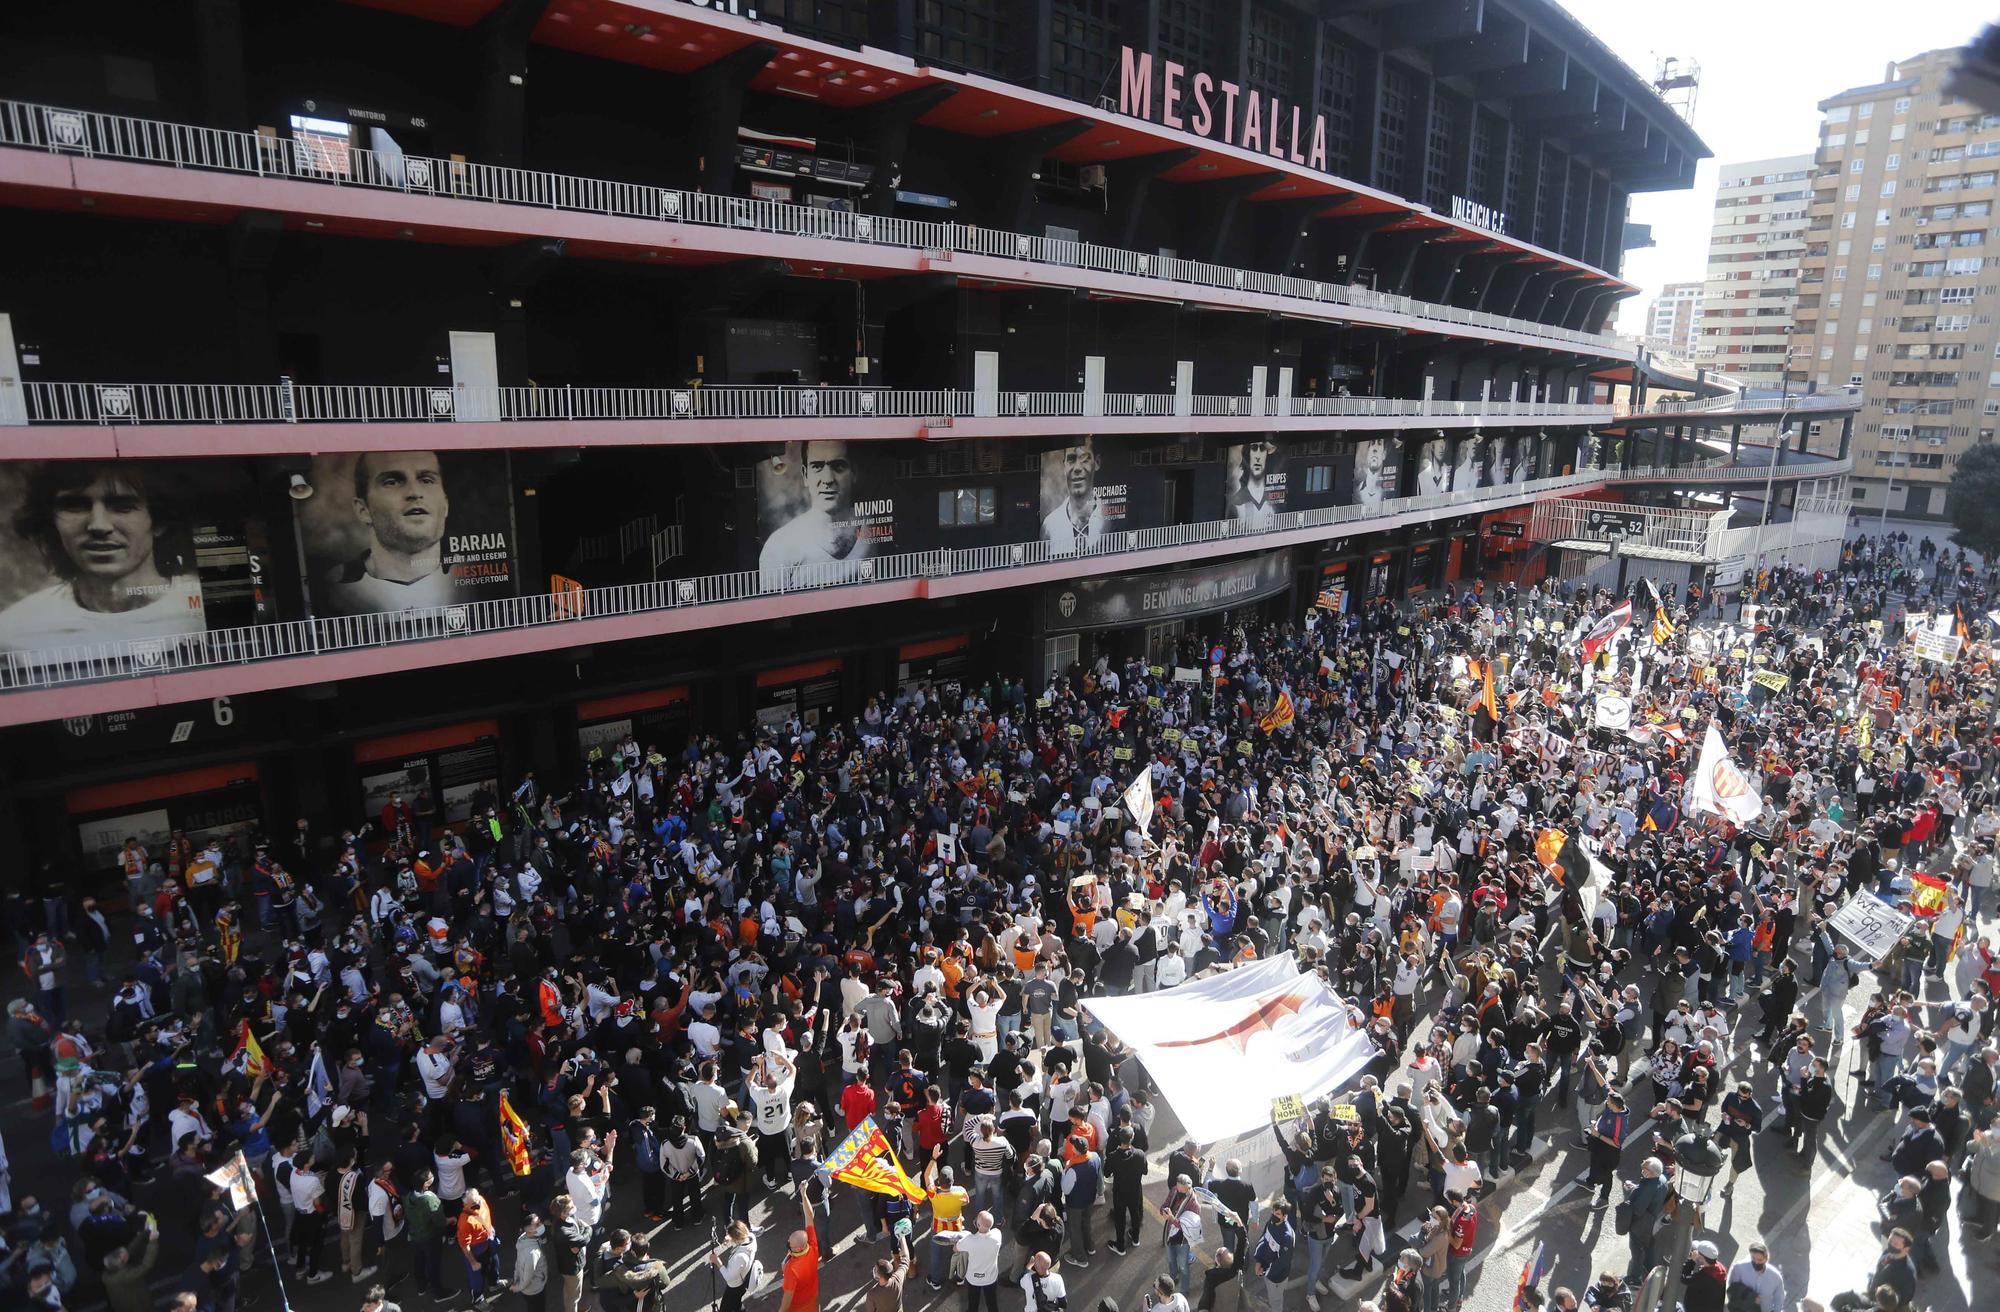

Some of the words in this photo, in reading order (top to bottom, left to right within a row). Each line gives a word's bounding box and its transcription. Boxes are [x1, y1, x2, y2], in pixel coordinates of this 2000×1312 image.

[1120, 45, 1327, 171] MESTALLA
[347, 108, 386, 121] VOMITORIO
[410, 117, 426, 128] 405
[1452, 195, 1490, 230] VALENCIA
[1491, 210, 1505, 235] C.F.
[854, 499, 893, 517] MUNDO
[876, 515, 893, 524] LEGEND
[1629, 521, 1643, 533] 52
[449, 532, 506, 553] BARAJA
[443, 554, 465, 565] HEART
[467, 553, 481, 562] AND
[482, 551, 507, 561] LEGEND
[451, 562, 509, 577] MESTALLA
[455, 574, 509, 587] FOREVERTOUR
[1143, 585, 1210, 611] BENVINGUTS
[1212, 586, 1218, 599] A
[1221, 573, 1257, 598] MESTALLA
[1755, 674, 1782, 690] HOME
[107, 711, 136, 724] PORTA
[212, 696, 234, 727] 6
[109, 723, 128, 733] GATE
[1856, 894, 1880, 916] WE
[1886, 917, 1908, 936] ARE
[1854, 916, 1886, 948] 99%
[1278, 1095, 1293, 1105] LIM
[1281, 1103, 1293, 1111] GO
[763, 1103, 784, 1119] 21
[1277, 1108, 1301, 1120] HOME
